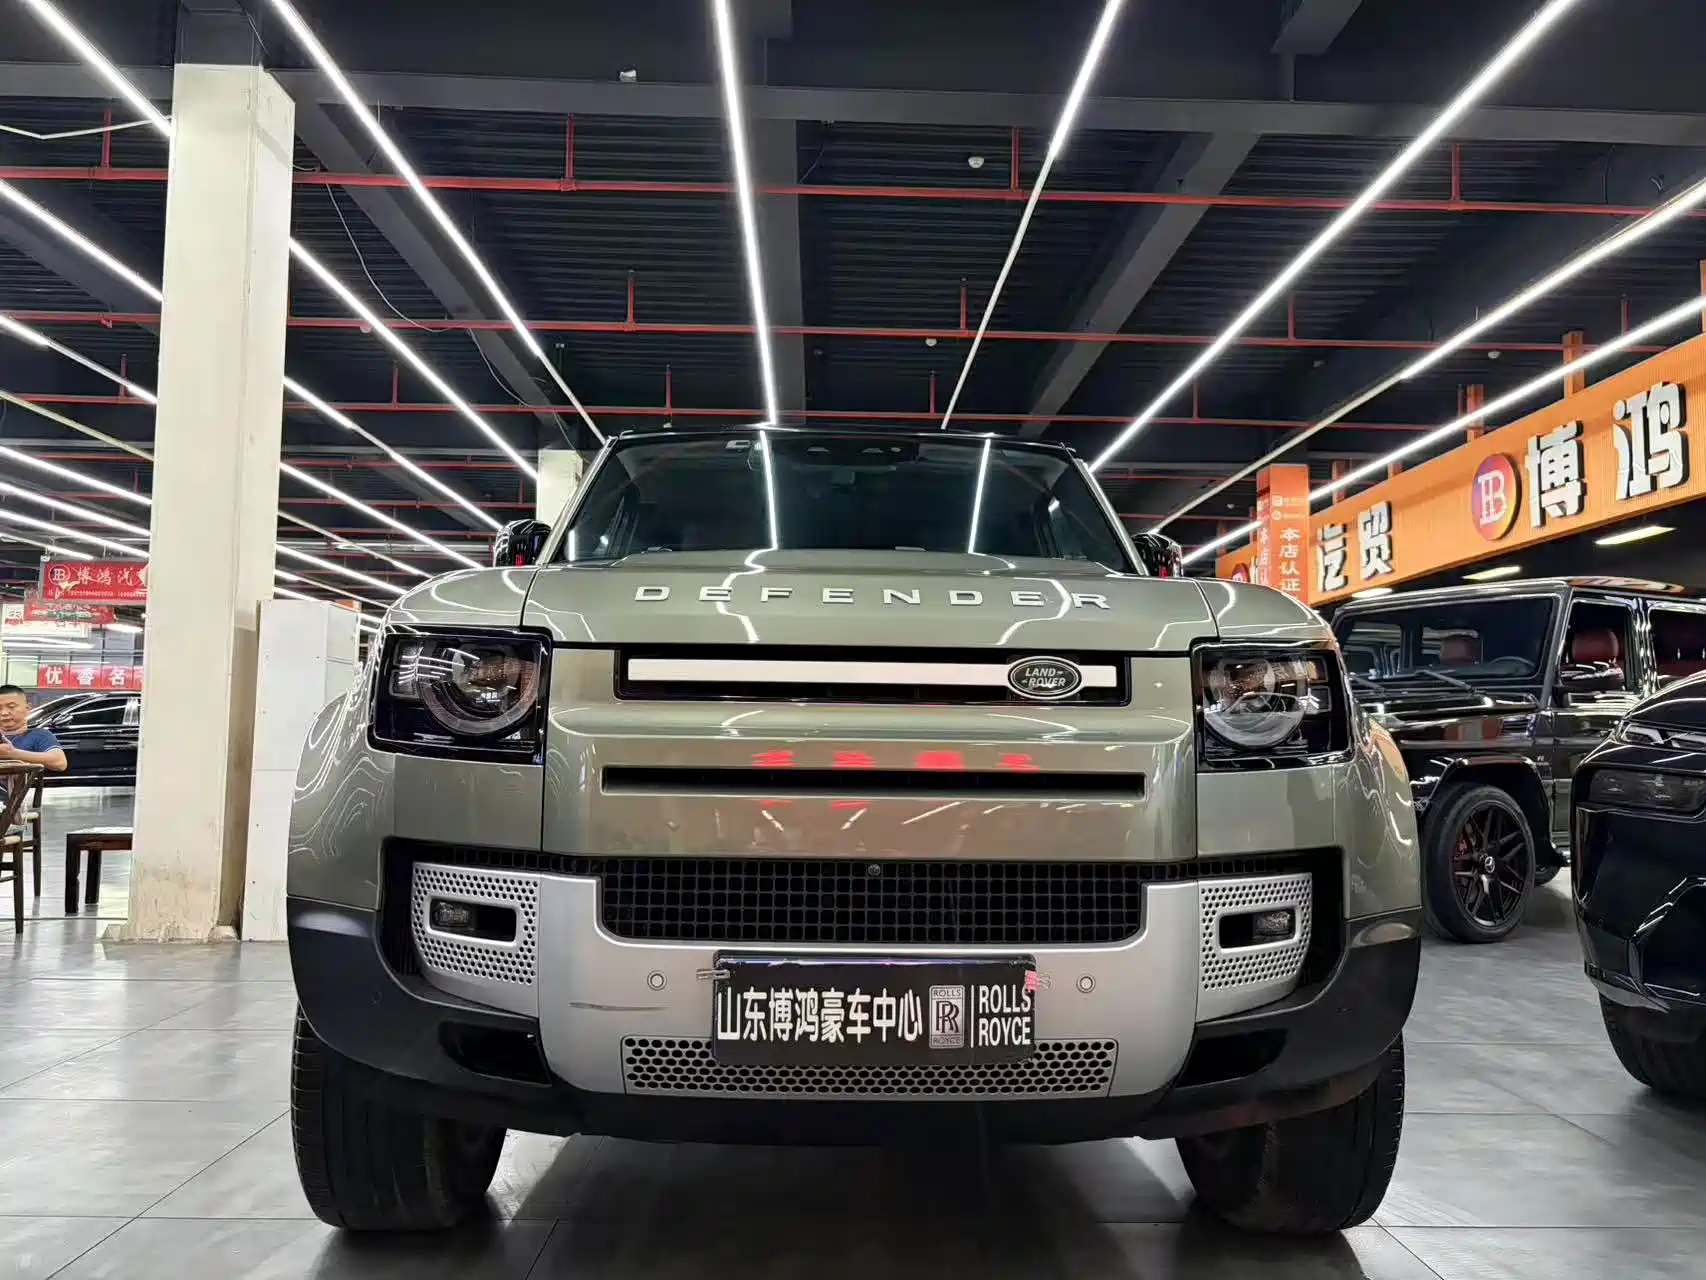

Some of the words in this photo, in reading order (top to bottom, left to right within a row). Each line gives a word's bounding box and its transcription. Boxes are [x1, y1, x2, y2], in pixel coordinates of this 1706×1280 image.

[1524, 381, 1689, 528] 博鸿
[1316, 501, 1394, 592] 汽贸
[634, 585, 1112, 610] DEFENDER
[45, 665, 143, 687] 优香名
[933, 990, 962, 998] ROLLS
[979, 984, 1032, 1014] ROLLS
[716, 985, 924, 1044] 山东博鸿豪车中心
[932, 1036, 962, 1045] ROYCE
[978, 1016, 1032, 1047] ROYCE
